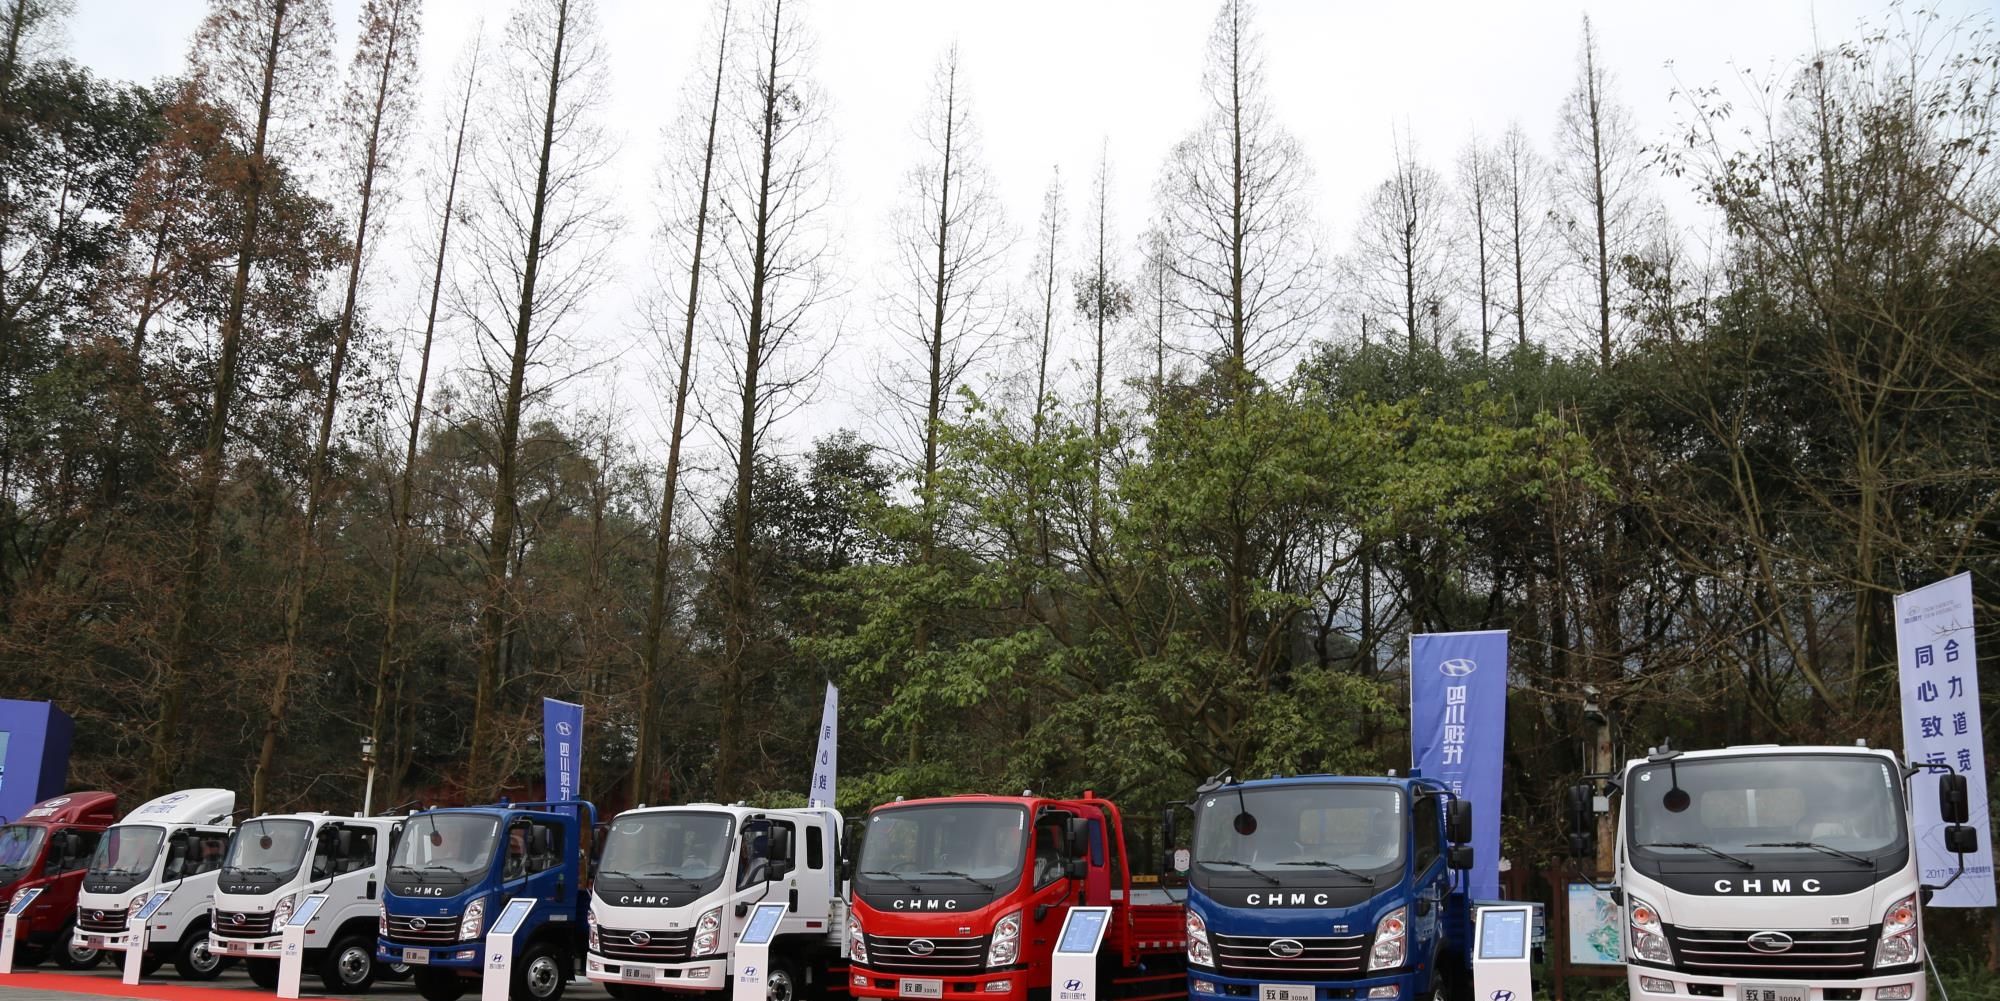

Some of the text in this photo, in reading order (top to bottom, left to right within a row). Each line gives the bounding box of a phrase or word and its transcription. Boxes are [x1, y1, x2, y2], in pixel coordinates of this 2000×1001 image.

[1915, 645, 1949, 774] 同心致远
[1944, 639, 1972, 773] 合力道宽
[1926, 868, 1945, 879] 2017
[404, 886, 443, 896] CHMC
[1714, 879, 1821, 893] CHMC
[620, 895, 669, 905] CHMC
[893, 899, 957, 909] CHMC
[1246, 893, 1328, 905] CHMC
